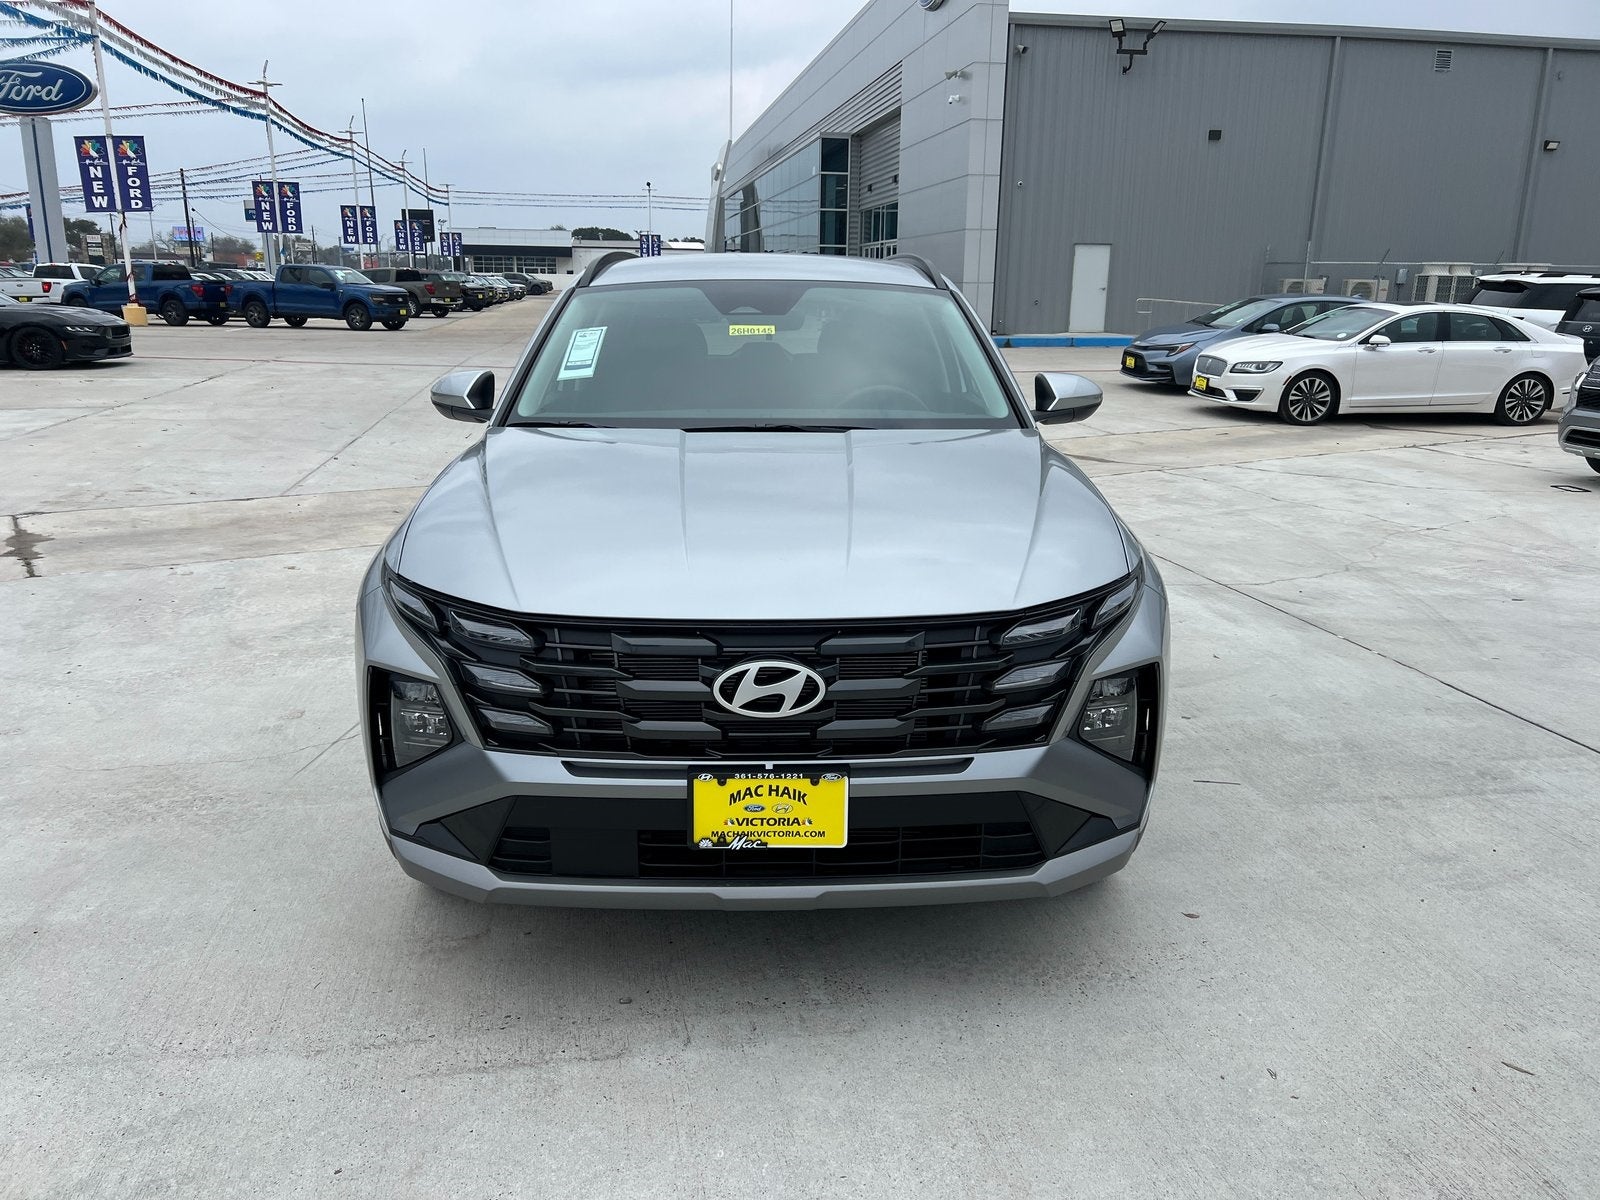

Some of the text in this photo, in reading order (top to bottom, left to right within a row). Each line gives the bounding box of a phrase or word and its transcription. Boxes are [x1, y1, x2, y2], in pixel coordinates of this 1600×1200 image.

[0, 69, 63, 101] Ford
[89, 166, 108, 208] NEW
[127, 166, 143, 209] FORD
[261, 201, 273, 230] NEW
[286, 202, 297, 231] FORD
[346, 220, 356, 243] NEW
[366, 221, 374, 243] FORD
[398, 232, 406, 250] NEW
[413, 232, 421, 250] FORD
[730, 327, 773, 335] 26H0145
[729, 784, 808, 806] MAC HAIK
[735, 817, 801, 827] VICTORIA
[711, 830, 826, 838] MACHAIKVICTORIA.COM
[729, 835, 762, 850] Mac
